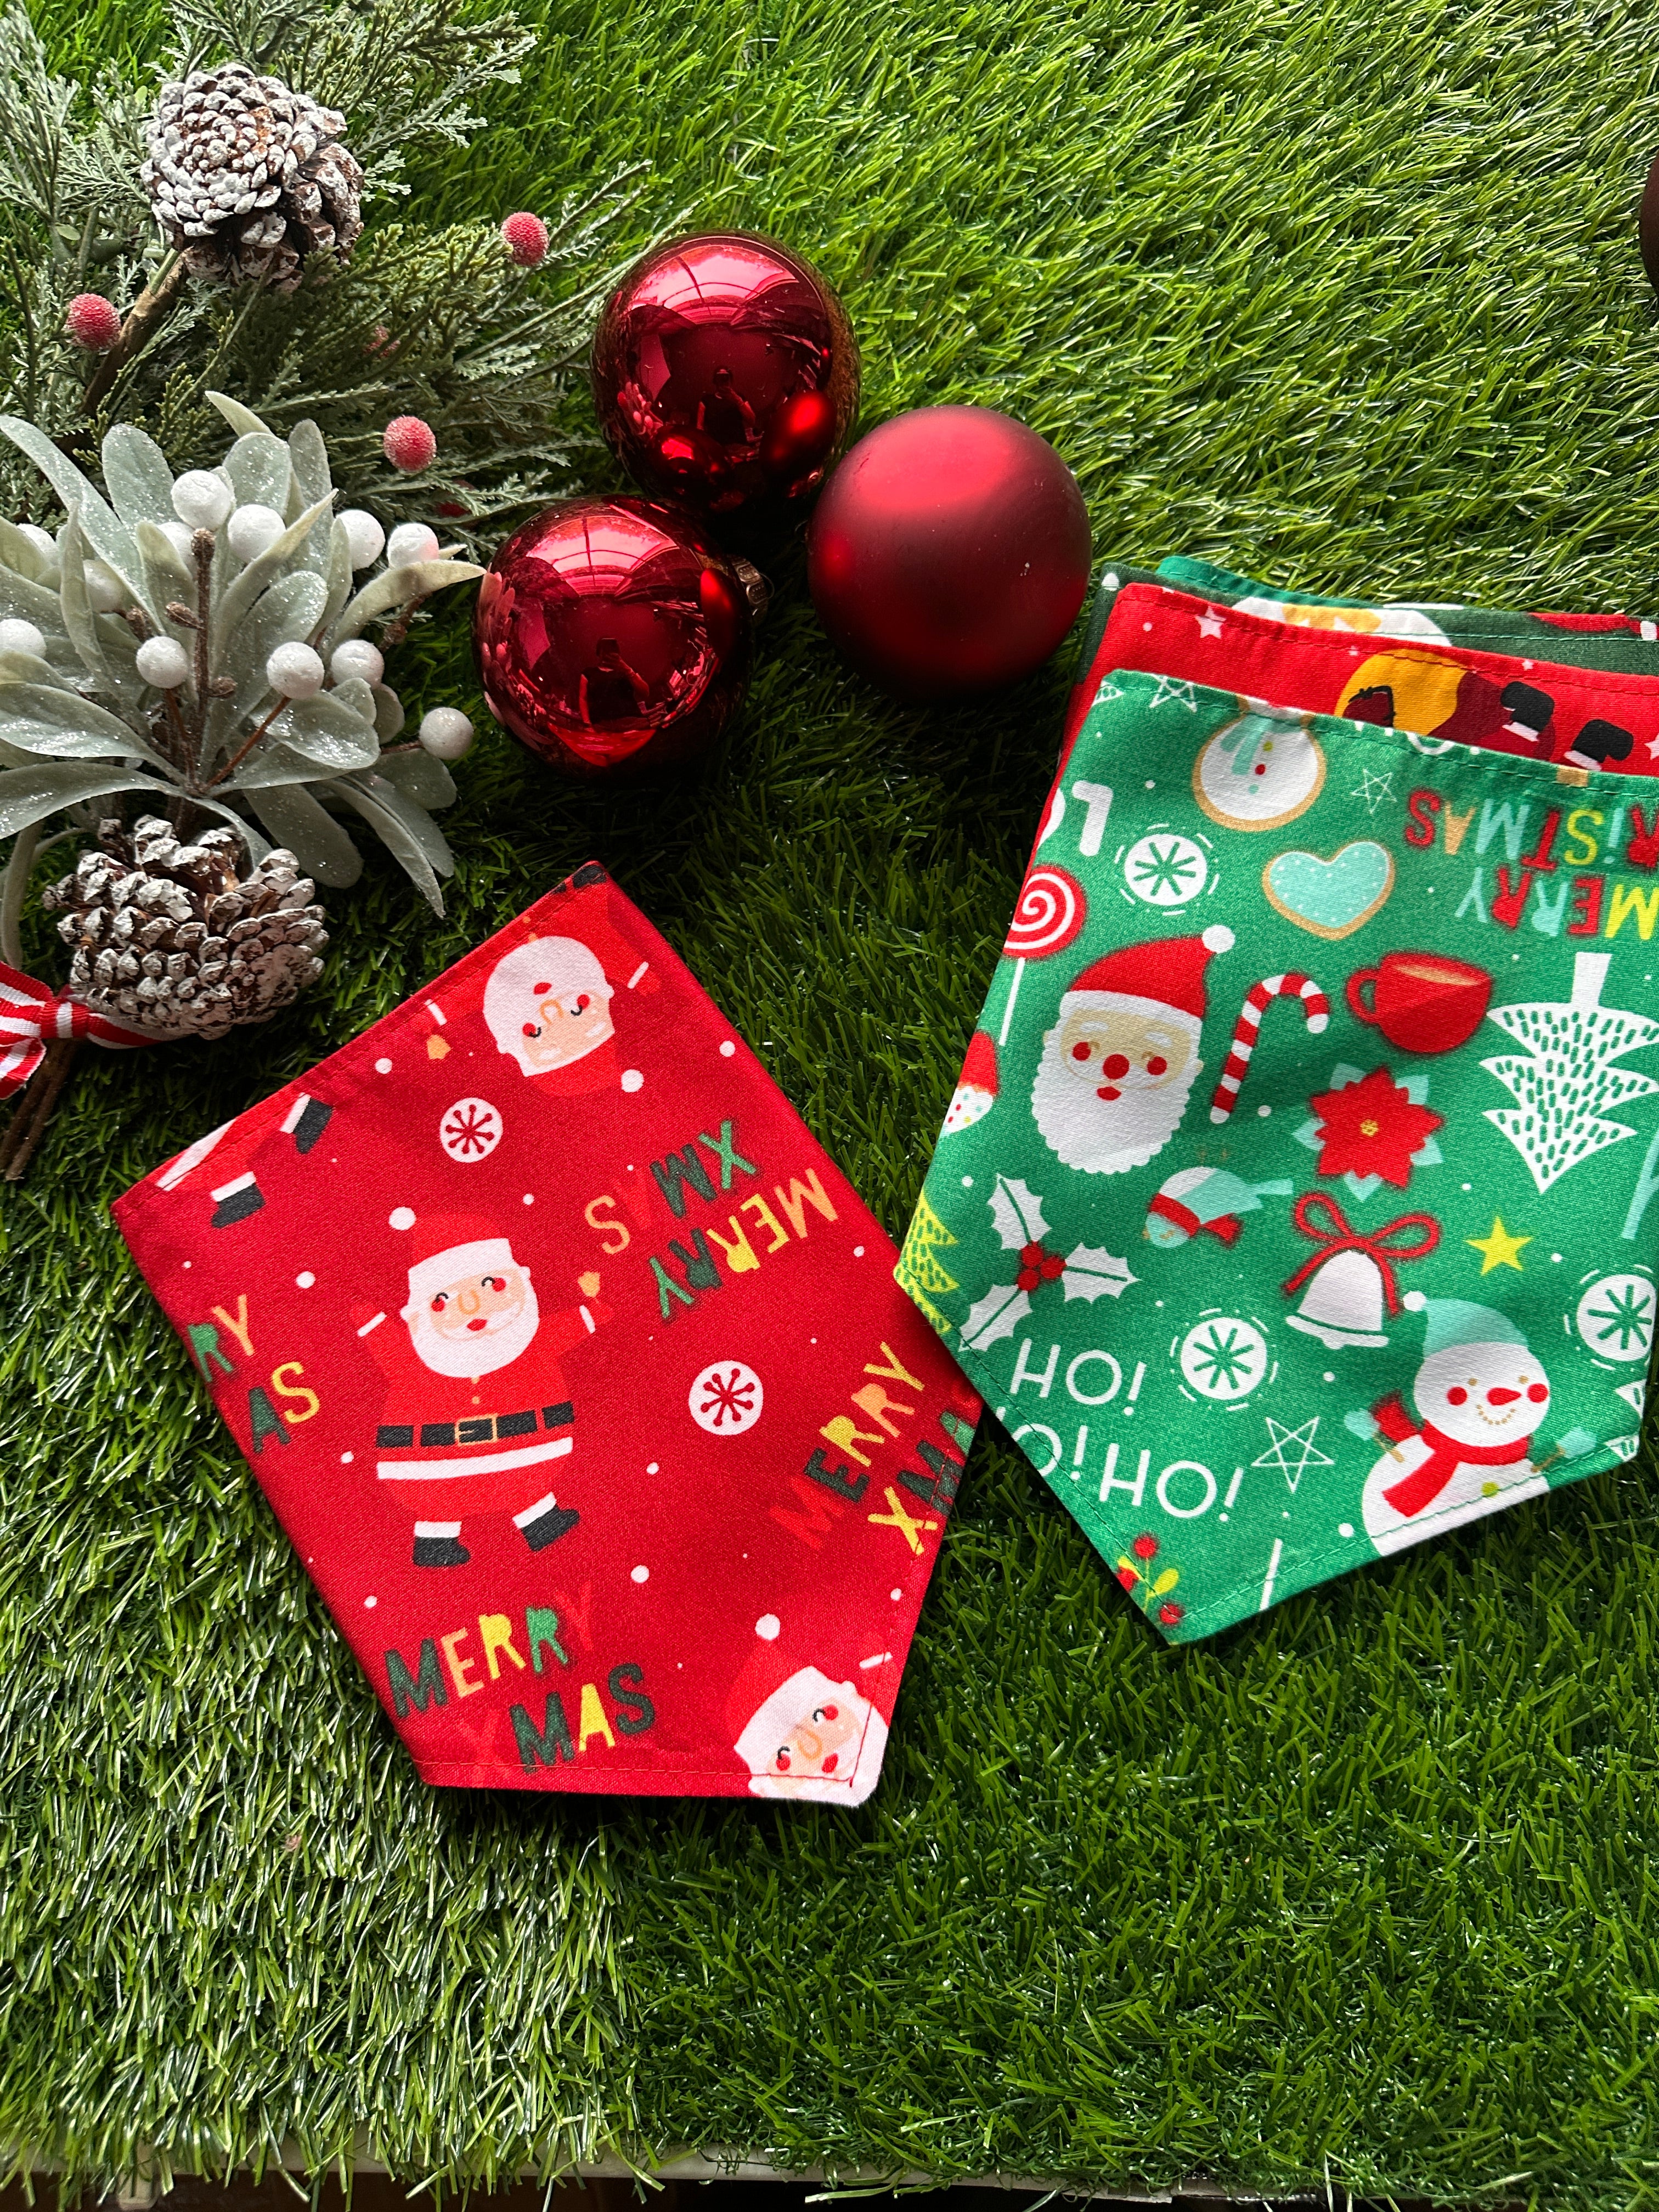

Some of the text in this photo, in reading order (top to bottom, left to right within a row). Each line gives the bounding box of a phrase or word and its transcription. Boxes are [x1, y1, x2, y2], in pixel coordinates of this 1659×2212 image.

[1454, 867, 1659, 940] MERRY
[648, 1167, 838, 1319] MERRY
[1008, 1338, 1147, 1416] HO!
[769, 1341, 925, 1549] MERRY
[996, 1406, 1244, 1522] O! HO!
[385, 1582, 593, 1719] MERRY
